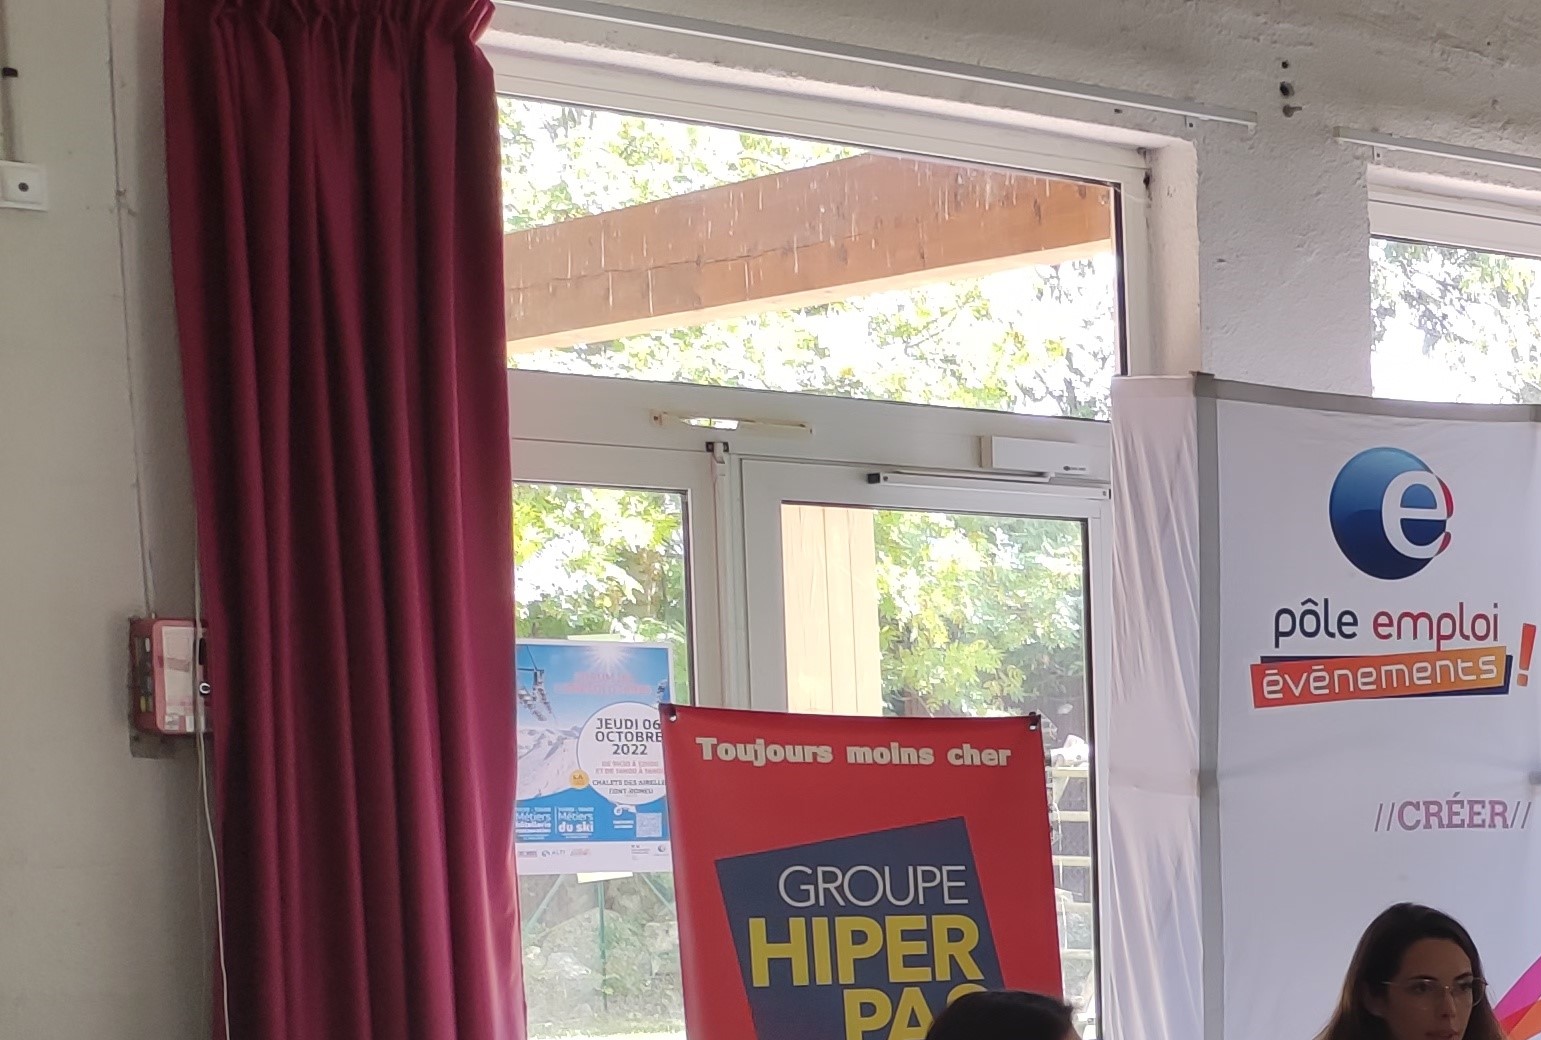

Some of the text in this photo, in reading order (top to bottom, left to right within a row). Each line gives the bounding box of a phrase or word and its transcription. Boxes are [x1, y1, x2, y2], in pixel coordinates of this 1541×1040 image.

[1274, 597, 1499, 652] pôle emploi
[596, 717, 661, 731] JEUDI 06
[595, 730, 664, 743] OCTOBRE
[612, 743, 648, 756] 2022
[695, 737, 1012, 767] Toujours moins cher
[558, 821, 574, 833] du
[575, 821, 594, 833] ski
[778, 865, 969, 908] GROUPE
[749, 914, 985, 988] HIPER
